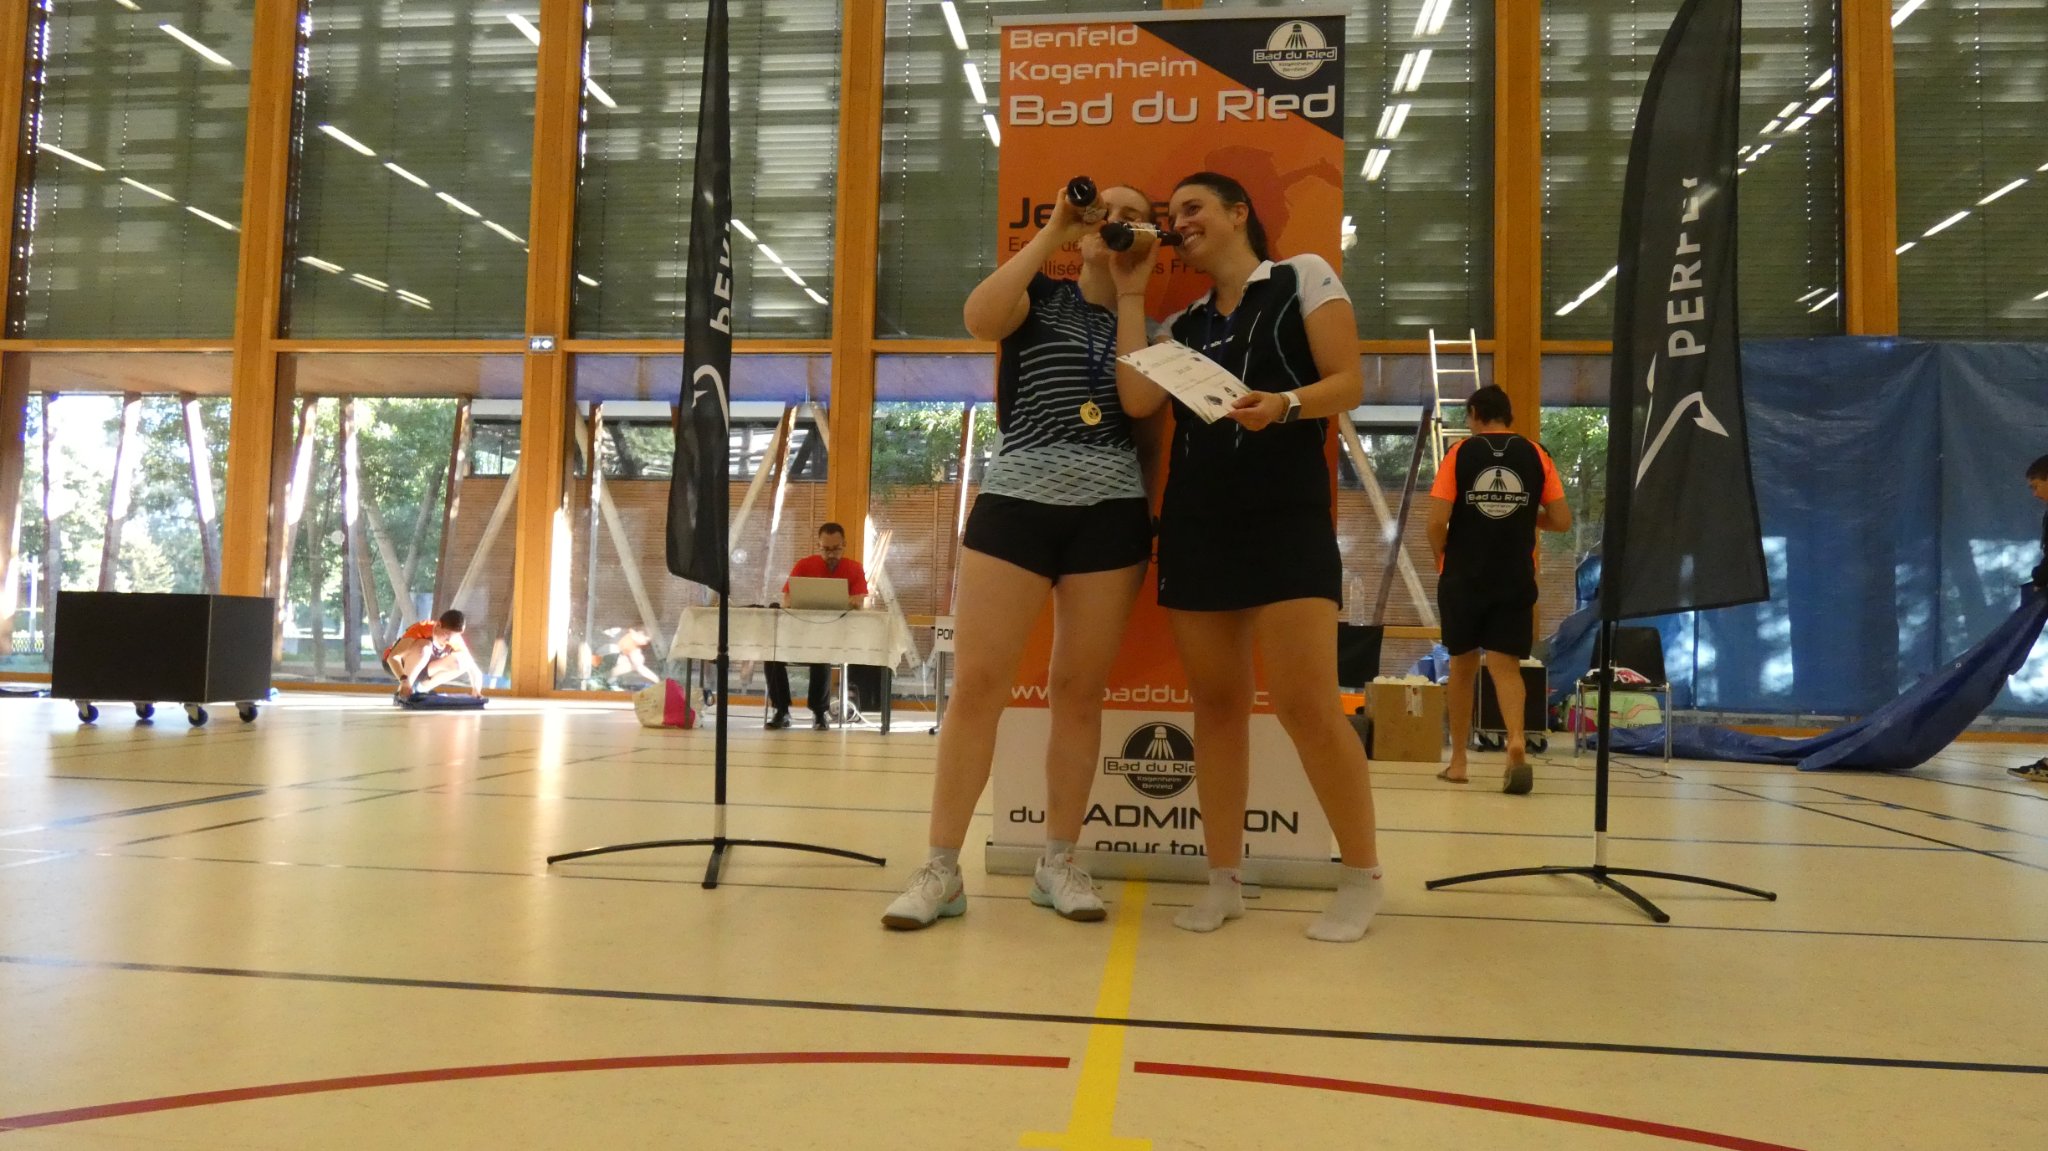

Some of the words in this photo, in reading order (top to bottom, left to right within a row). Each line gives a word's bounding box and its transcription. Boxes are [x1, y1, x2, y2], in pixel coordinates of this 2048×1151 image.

[1010, 25, 1138, 49] Benfeld
[1256, 51, 1282, 60] Bad
[1285, 50, 1302, 60] du
[1306, 49, 1335, 59] Ried
[1009, 56, 1197, 84] Kogenheim
[1009, 92, 1113, 125] Bad
[1132, 91, 1198, 123] du
[1217, 85, 1336, 121] Ried
[1468, 493, 1489, 501] Bad
[1490, 493, 1502, 501] du
[1505, 494, 1527, 502] Ried
[1107, 761, 1140, 771] Bad
[1146, 762, 1167, 772] du
[1173, 763, 1196, 773] Rie
[1010, 806, 1045, 823] du
